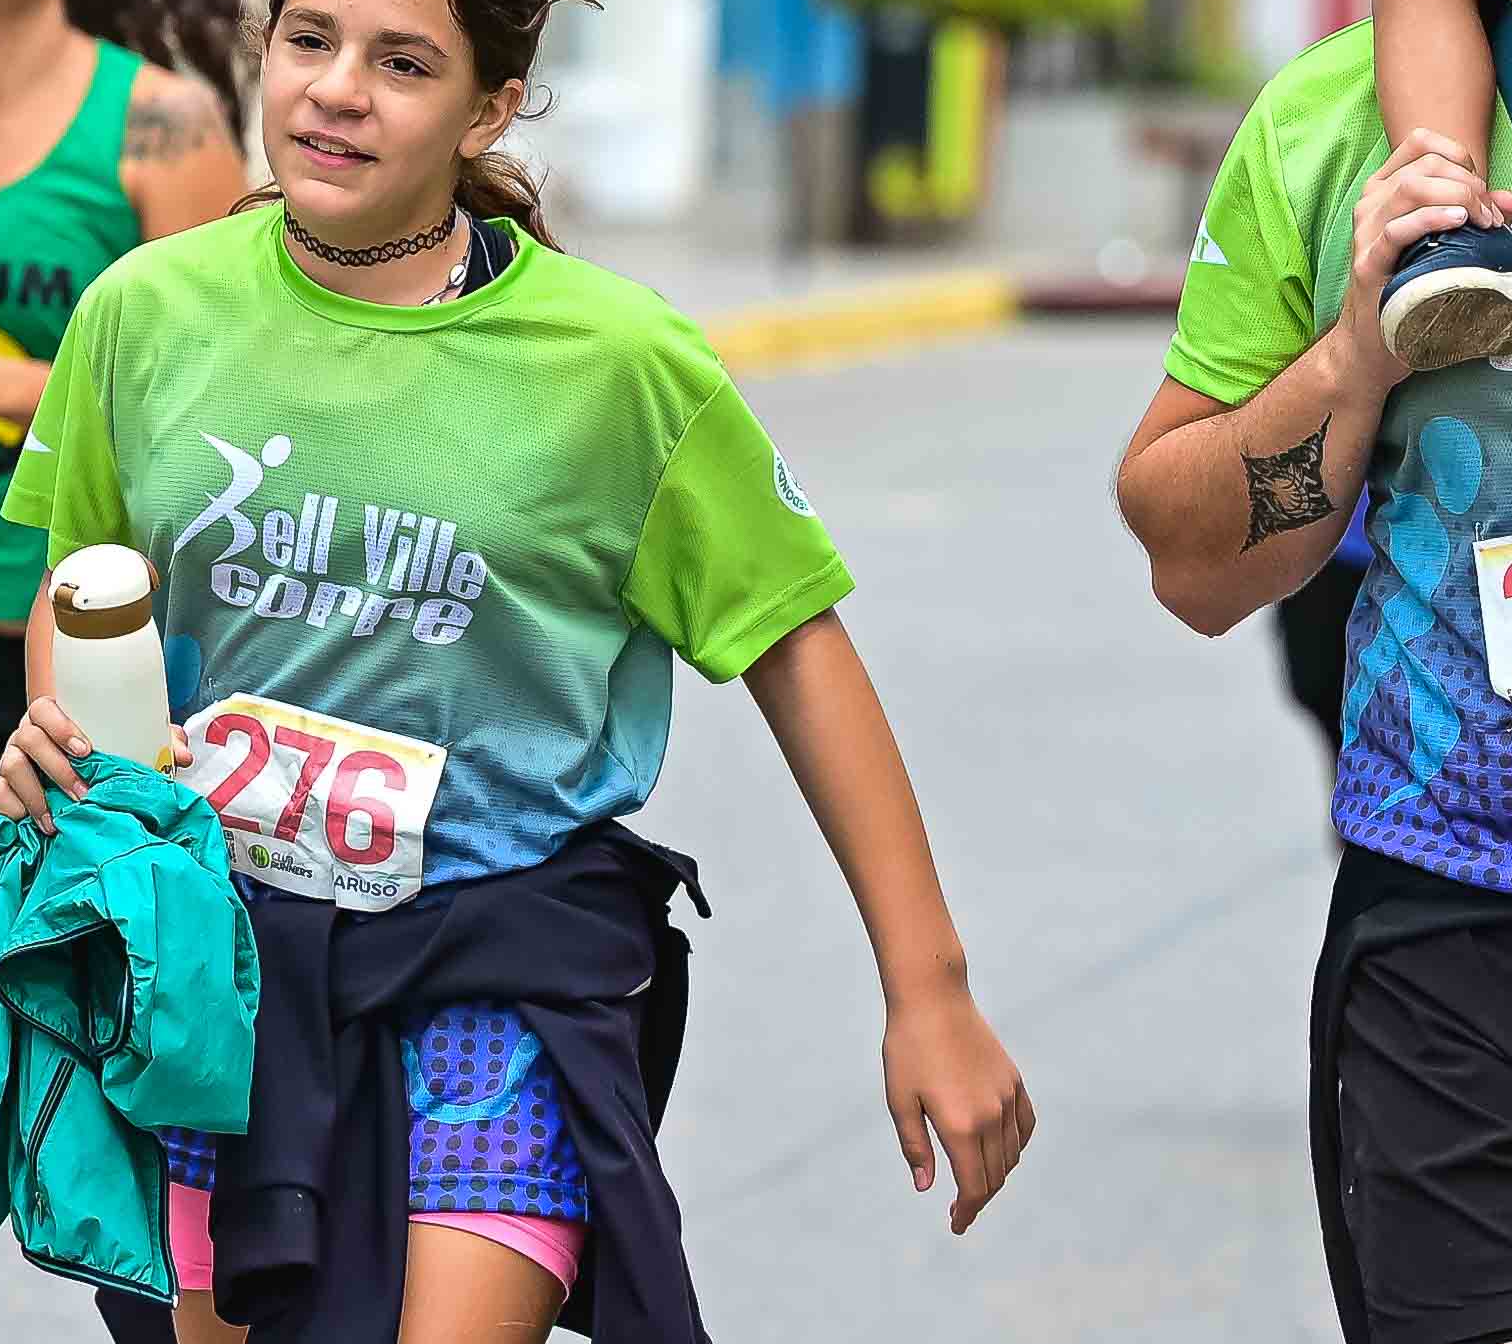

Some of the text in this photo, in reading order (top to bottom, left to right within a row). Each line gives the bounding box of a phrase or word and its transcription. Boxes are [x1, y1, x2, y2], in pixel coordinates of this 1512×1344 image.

[364, 504, 487, 600] Ville
[211, 563, 474, 645] corre
[204, 713, 407, 866] 276
[334, 874, 399, 898] ARUSO
